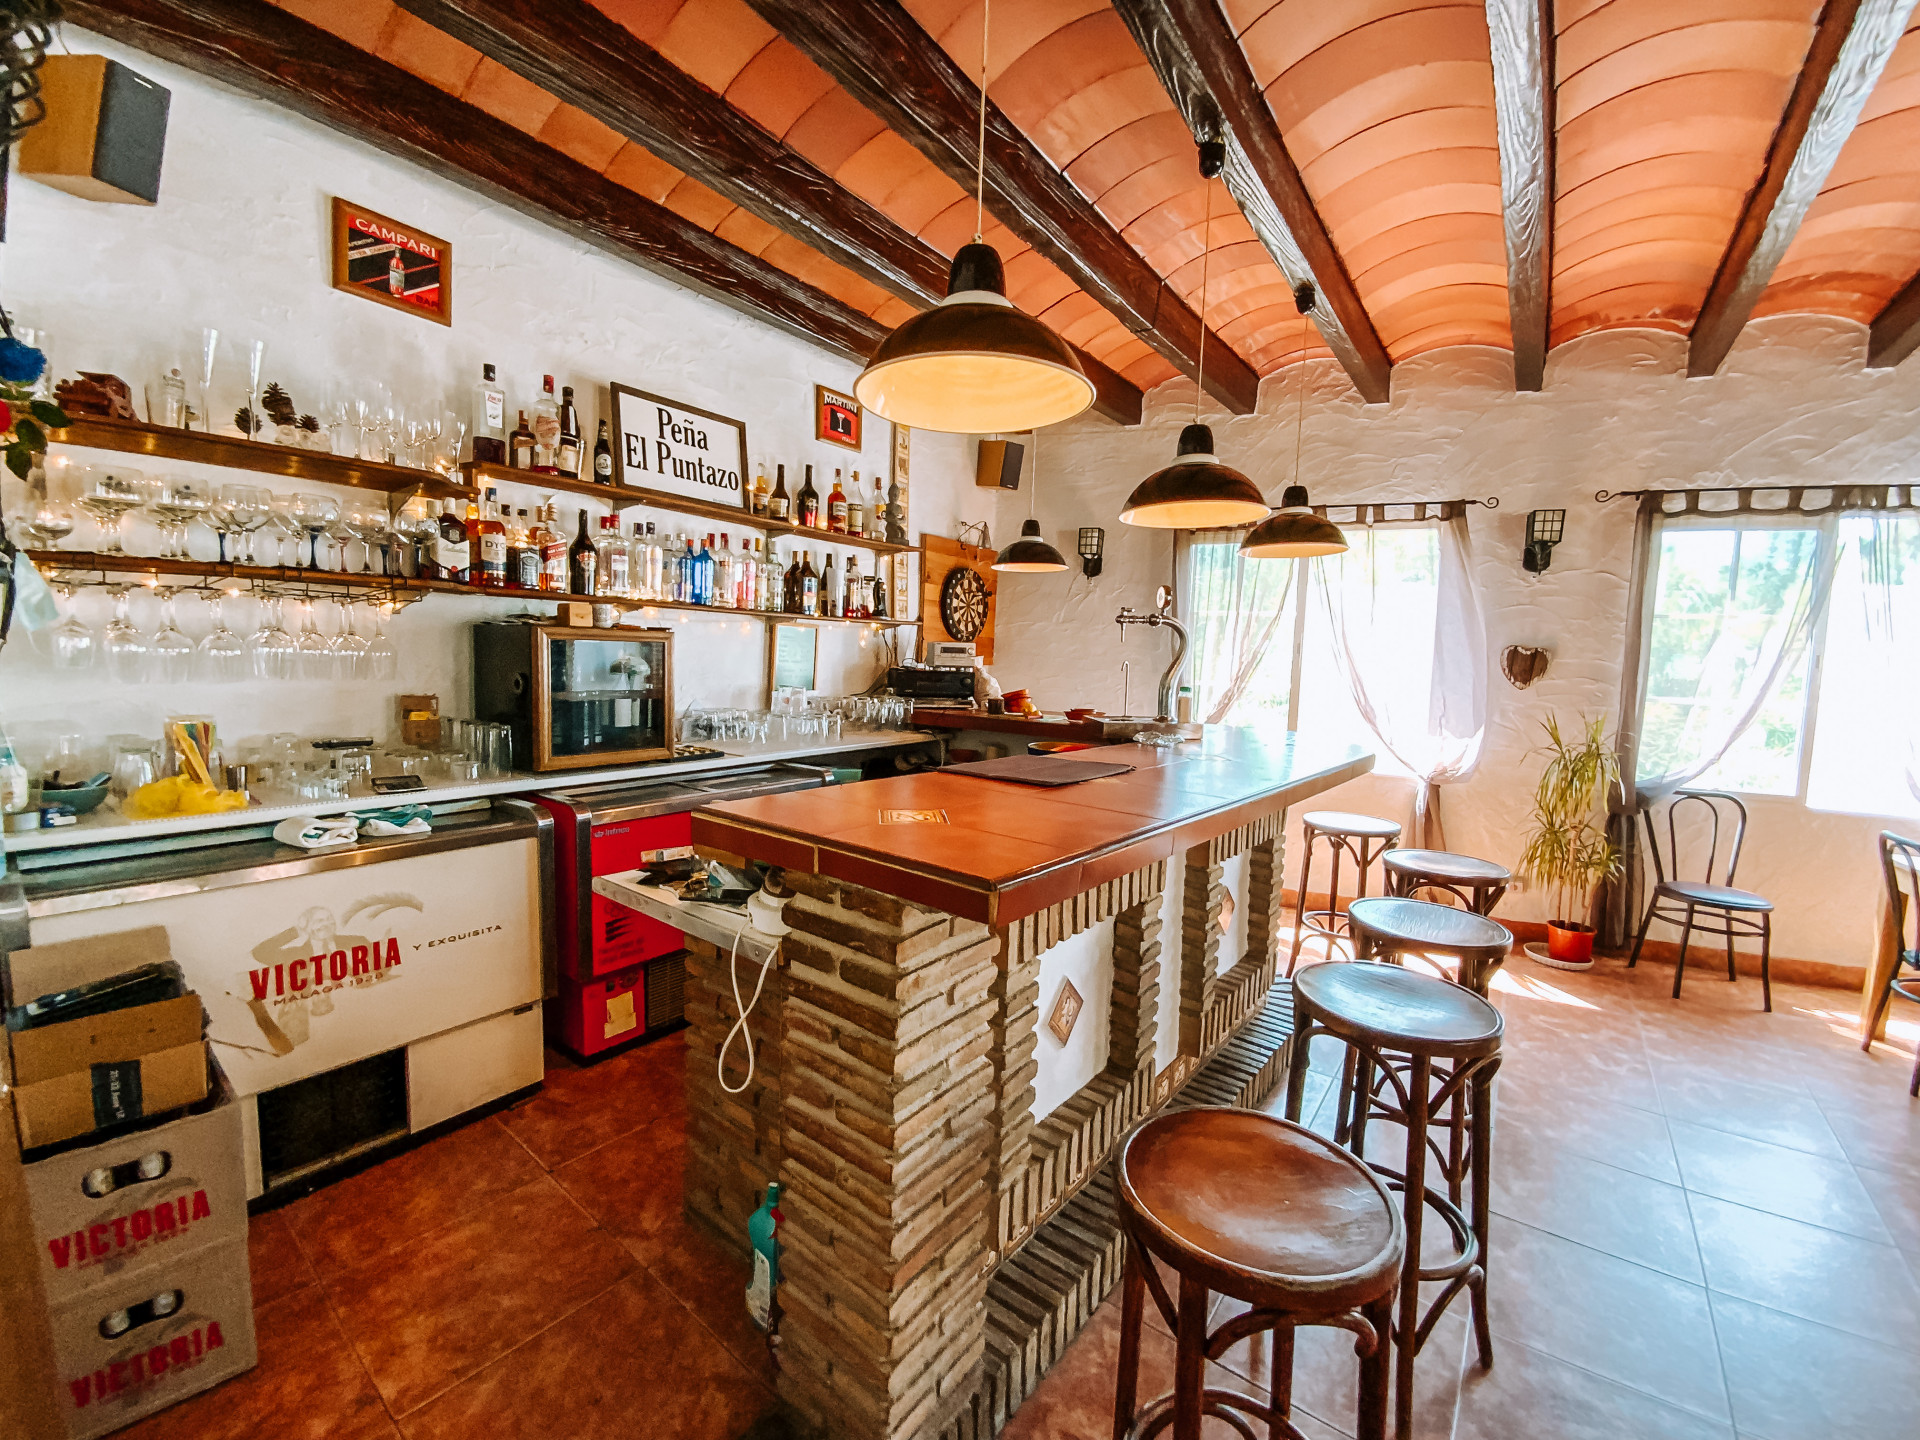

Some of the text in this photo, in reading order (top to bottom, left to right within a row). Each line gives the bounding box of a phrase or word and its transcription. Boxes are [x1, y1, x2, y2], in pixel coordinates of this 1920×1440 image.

[355, 218, 436, 258] CAMPARI
[823, 391, 858, 413] MARTINI
[656, 406, 709, 451] Peña
[624, 432, 740, 491] El Puntazo
[428, 925, 502, 948] EXQUISITA
[248, 937, 402, 1000] VICTORIA
[48, 1189, 211, 1269] VICTORIA
[70, 1321, 224, 1408] VICTORIA
